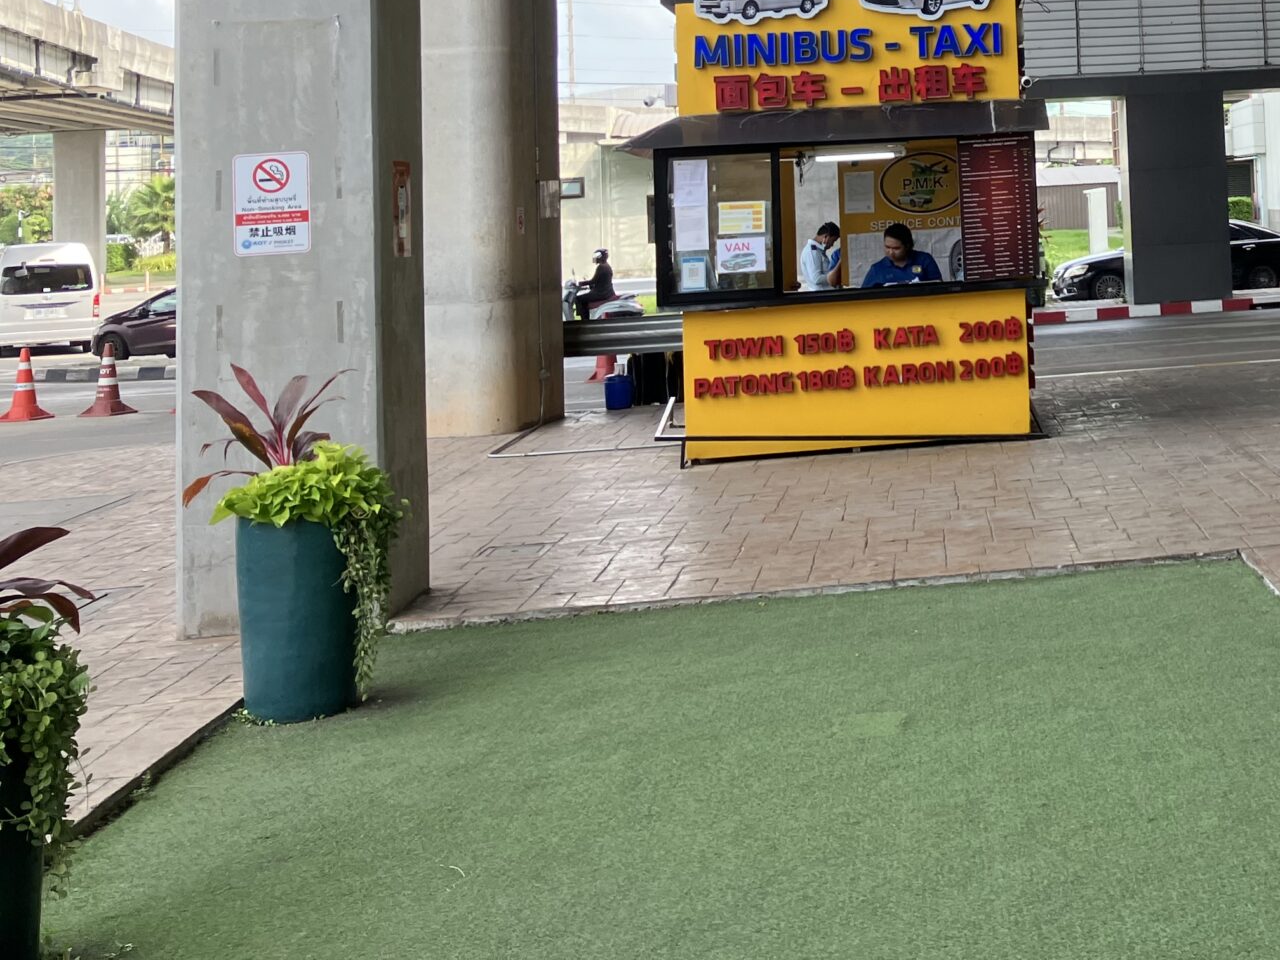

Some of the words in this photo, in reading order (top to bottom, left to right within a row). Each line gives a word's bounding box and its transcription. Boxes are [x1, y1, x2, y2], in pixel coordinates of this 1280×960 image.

[694, 27, 873, 69] MINIBUS
[909, 22, 1003, 59] TAXI
[713, 70, 827, 113] 面包车
[878, 63, 988, 103] 出租车
[903, 177, 949, 191] P.M.K.
[249, 226, 296, 238] 禁止吸烟
[724, 243, 751, 252] VAN
[704, 336, 783, 360] TOWN
[873, 325, 939, 350] KATA
[694, 371, 794, 398] PATONG
[863, 360, 955, 388] KARON
